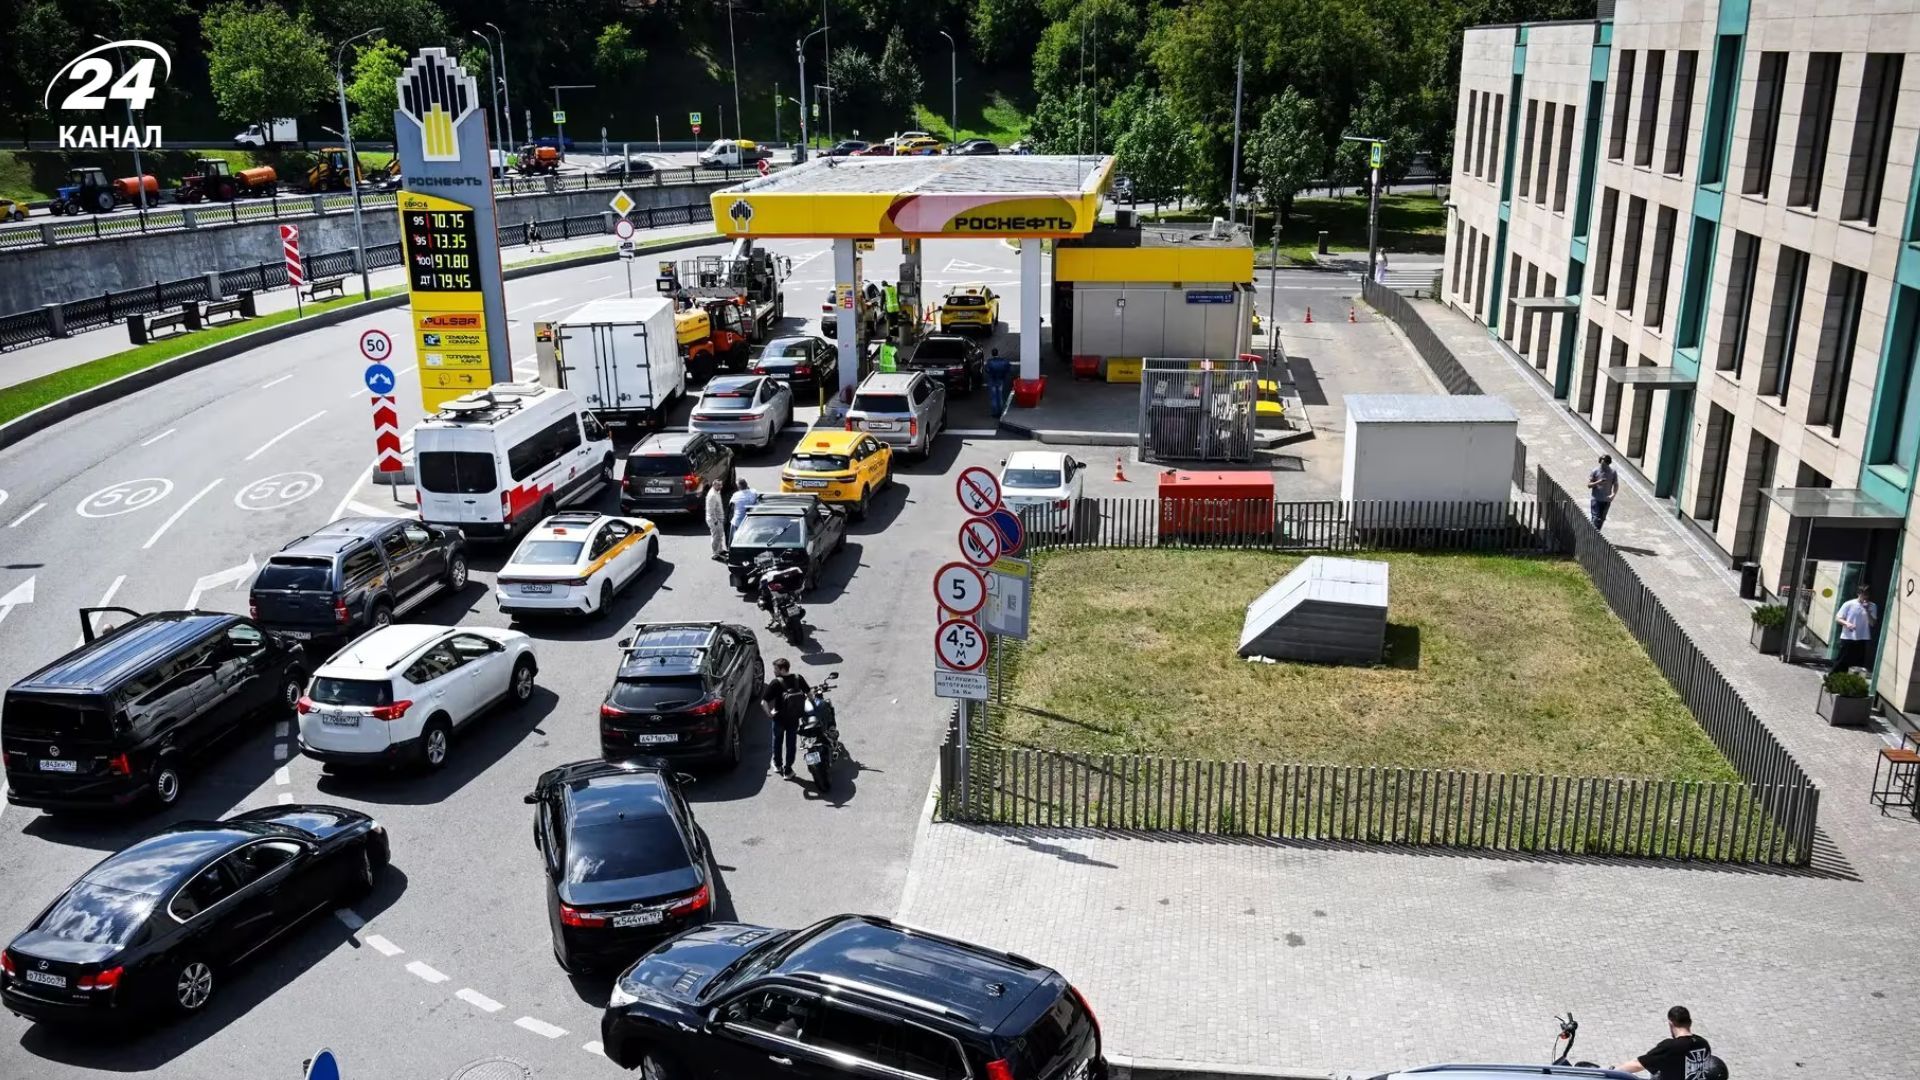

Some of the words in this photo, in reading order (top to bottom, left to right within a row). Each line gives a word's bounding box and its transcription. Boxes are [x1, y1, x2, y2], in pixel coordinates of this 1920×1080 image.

[408, 177, 482, 187] РОСНЕФТЬ
[413, 216, 424, 226] 95
[432, 213, 464, 228] 70.75
[954, 217, 1073, 230] РОСНЕФТЬ
[415, 236, 427, 246] 95
[434, 234, 467, 248] 73.35
[418, 256, 431, 266] 100
[435, 254, 469, 269] 97.80
[420, 275, 431, 286] ДТ
[438, 274, 471, 288] 79.45
[366, 339, 386, 352] 50
[93, 486, 158, 507] 50
[248, 481, 309, 500] 50
[952, 579, 966, 600] 5
[1907, 578, 1915, 597] 9
[946, 629, 976, 649] 4,5
